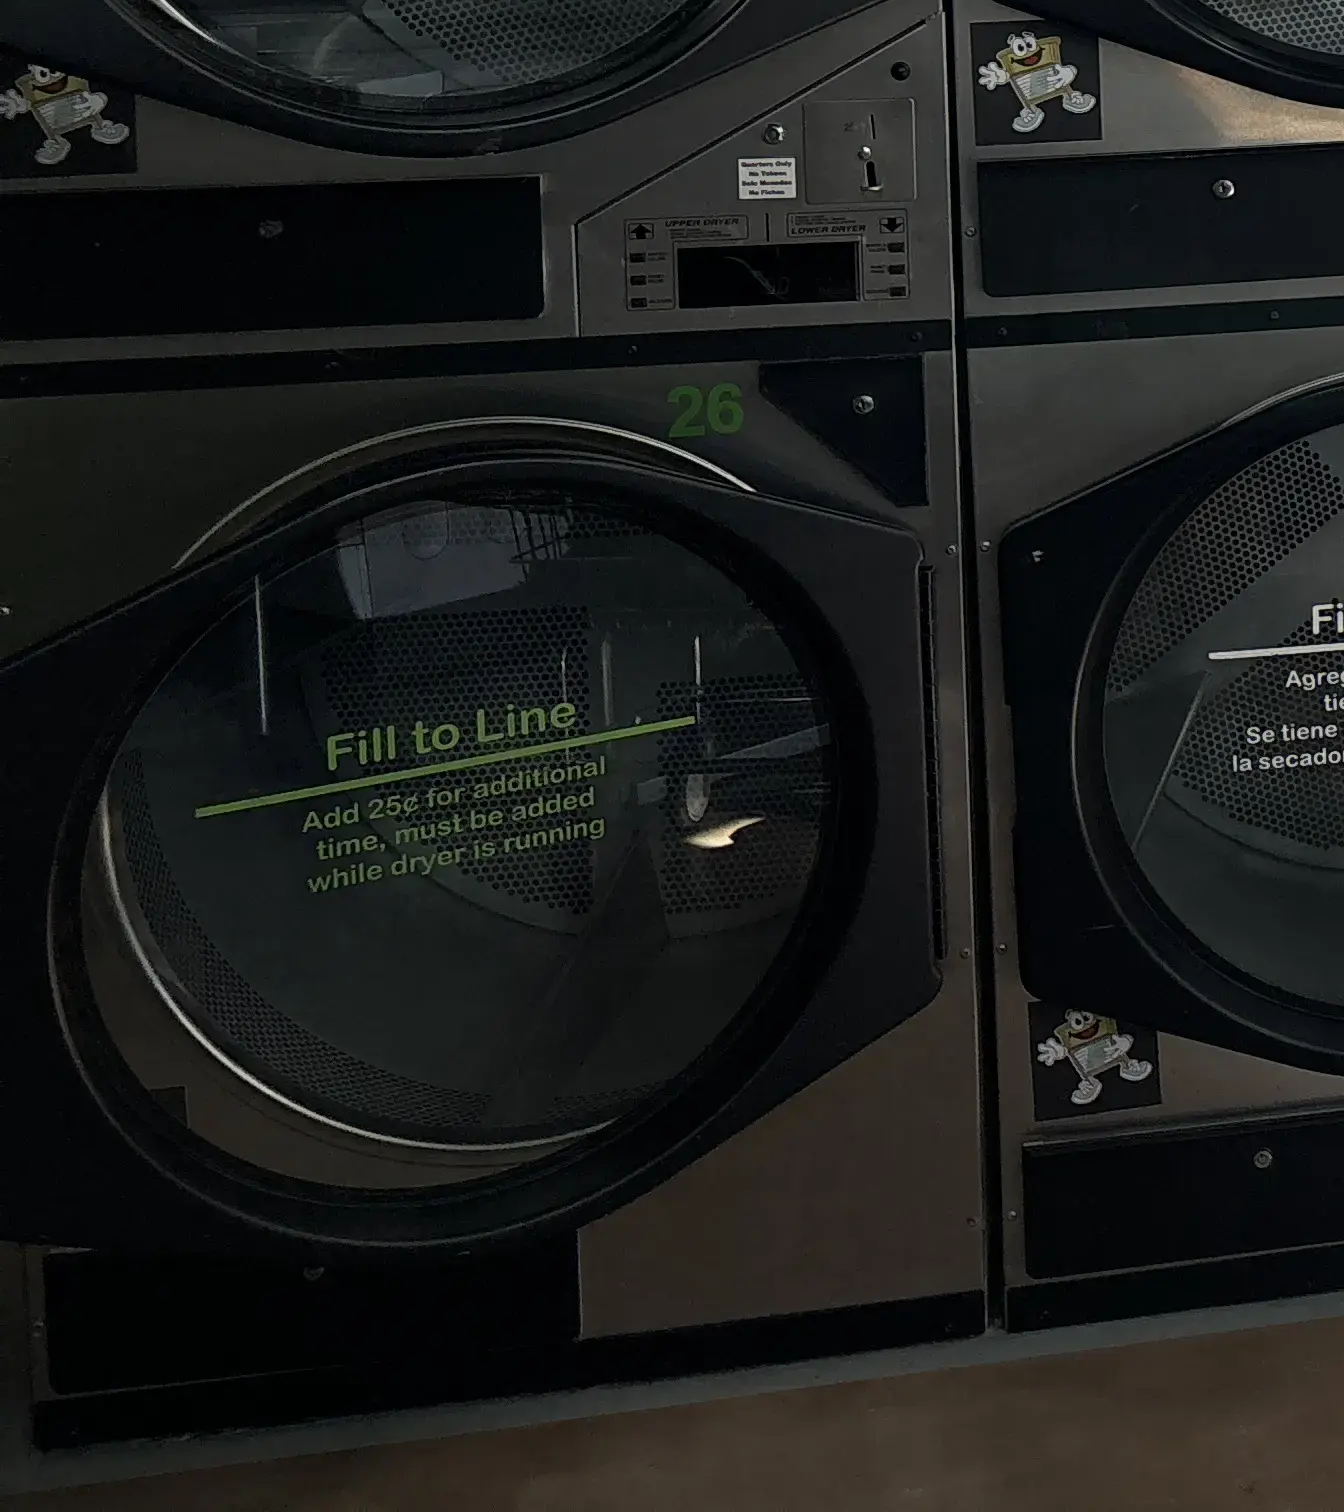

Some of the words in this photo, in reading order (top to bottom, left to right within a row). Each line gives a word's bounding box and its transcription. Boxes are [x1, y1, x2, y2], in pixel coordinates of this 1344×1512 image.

[665, 219, 701, 228] UPPER
[703, 218, 739, 226] DRYER
[791, 226, 829, 235] LOWER
[831, 224, 867, 233] DRYER
[667, 382, 744, 438] 26
[327, 724, 396, 772] Fill
[412, 719, 460, 755] to
[476, 701, 576, 743] Line
[1246, 725, 1275, 746] Se
[1281, 721, 1338, 742] tiene
[1232, 754, 1253, 773] la
[303, 802, 359, 833] Add
[368, 794, 419, 818] 25¢
[427, 782, 467, 808] for
[473, 756, 606, 800] additional
[316, 834, 386, 861] time,
[395, 816, 464, 845] must
[470, 802, 503, 829] be
[511, 786, 596, 822] added
[308, 861, 383, 893] while
[390, 846, 467, 877] dryer
[474, 838, 496, 861] is
[503, 817, 606, 855] running
